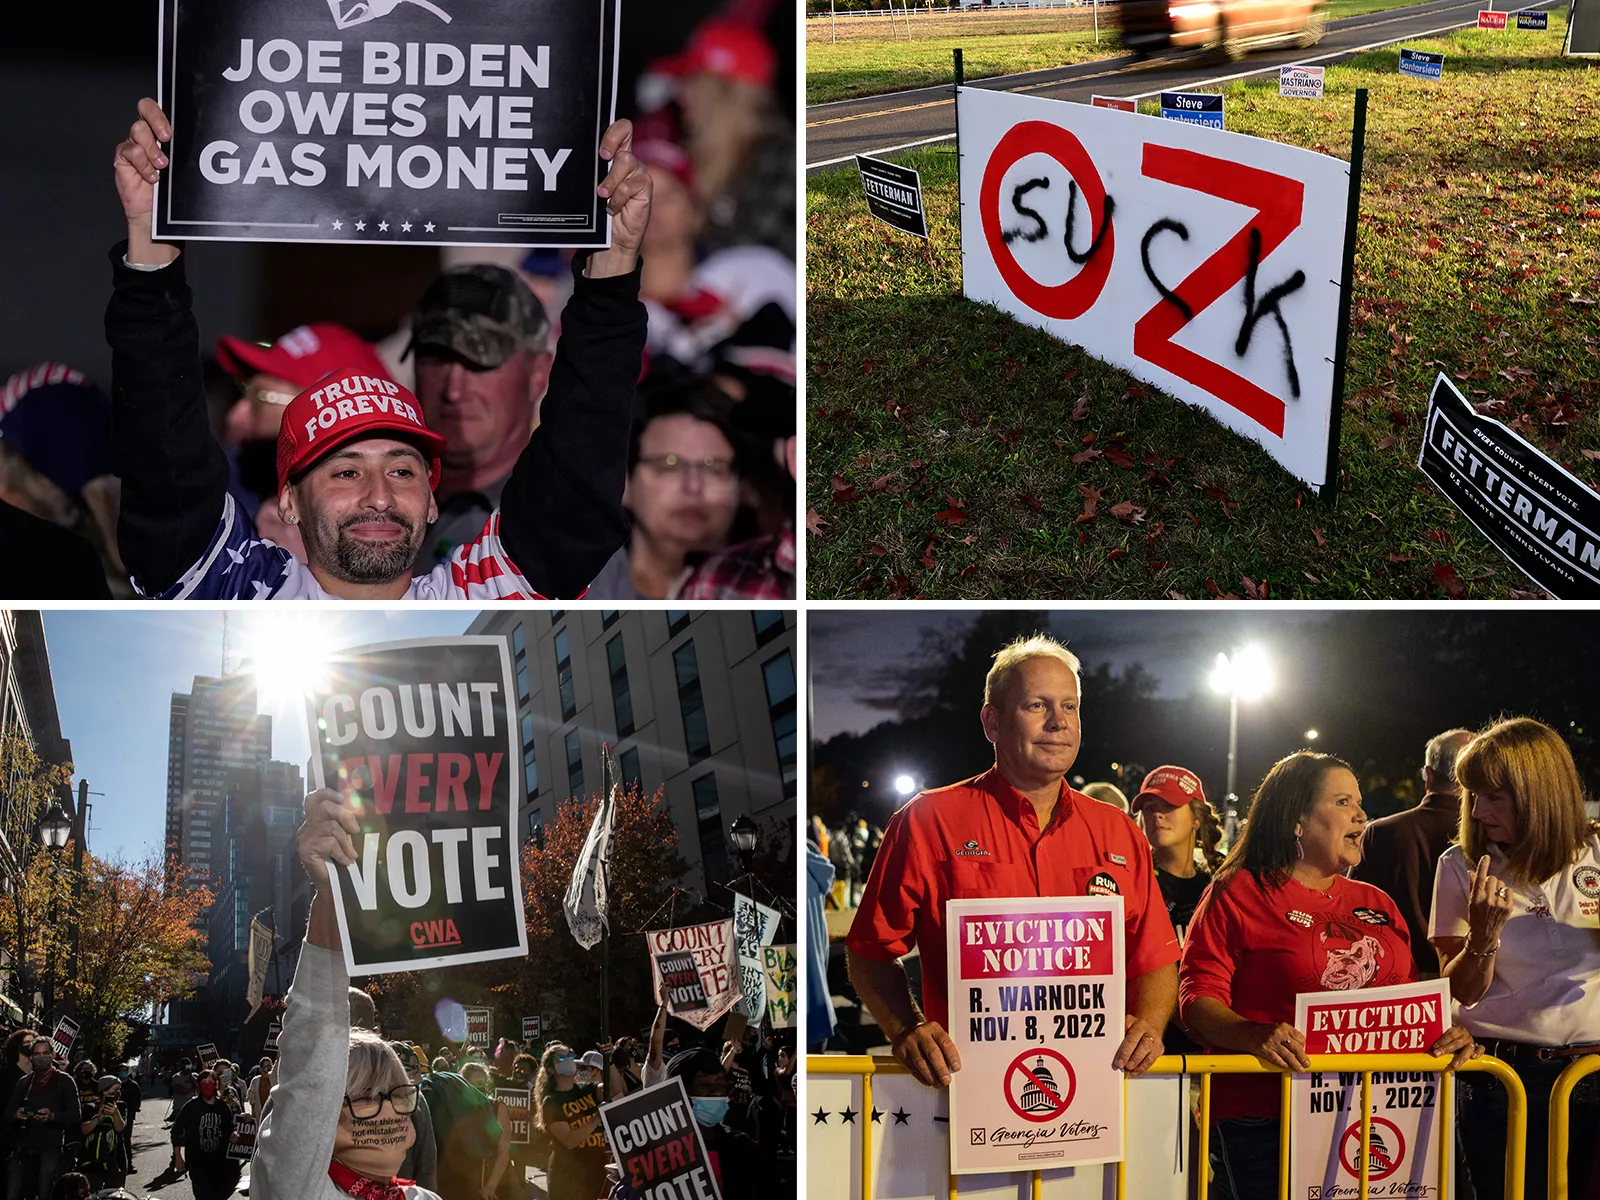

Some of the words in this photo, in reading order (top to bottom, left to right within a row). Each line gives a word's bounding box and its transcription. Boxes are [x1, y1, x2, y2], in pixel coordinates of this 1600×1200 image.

[222, 39, 342, 84] JOE
[363, 41, 550, 88] BIDEN
[1401, 59, 1440, 76] Santarsiero
[1411, 51, 1430, 62] Steve
[1281, 77, 1322, 88] MASTRIANO
[1283, 89, 1317, 97] GOVERNOR
[239, 89, 427, 137] OWES
[447, 95, 533, 140] ME
[1176, 96, 1203, 109] Steve
[199, 140, 326, 186] GAS
[346, 144, 572, 191] MONEY
[865, 178, 913, 206] FETTERMAN
[979, 120, 1305, 439] OZ
[1002, 177, 1306, 398] SUCK
[310, 375, 399, 410] TRUMP
[305, 395, 422, 442] FOREVER
[1472, 427, 1494, 447] EVERY
[1528, 470, 1554, 492] EVERY
[1441, 430, 1600, 571] FETTERMAN
[1464, 488, 1495, 519] SENATE
[1504, 525, 1576, 583] PENNSYLVANIA
[323, 682, 498, 746] COUNT
[336, 752, 504, 815] EVERY
[1095, 876, 1116, 892] RUN
[410, 919, 461, 945] CWA
[655, 921, 726, 954] COUNT
[966, 918, 1105, 945] EVICTION
[660, 957, 694, 974] COUNT
[982, 946, 1091, 973] NOTICE
[670, 984, 704, 1004] VOTE
[969, 987, 990, 1013] R.
[999, 984, 1105, 1012] WARNOCK
[467, 1015, 487, 1024] COUNT
[970, 1016, 1016, 1042] NOV.
[1025, 1016, 1045, 1044] 8,
[1054, 1013, 1106, 1040] 2022
[1312, 1000, 1437, 1032] EVICTION
[1325, 1028, 1425, 1054] NOTICE
[1310, 1090, 1351, 1113] NOV.
[1386, 1086, 1435, 1109] 2022
[352, 1129, 366, 1137] not
[357, 1118, 378, 1127] wear
[614, 1100, 688, 1154] COUNT
[989, 1127, 1056, 1149] Georgia
[1060, 1119, 1108, 1137] Voters
[627, 1132, 697, 1188] EVERY
[1389, 1179, 1437, 1197] Voters
